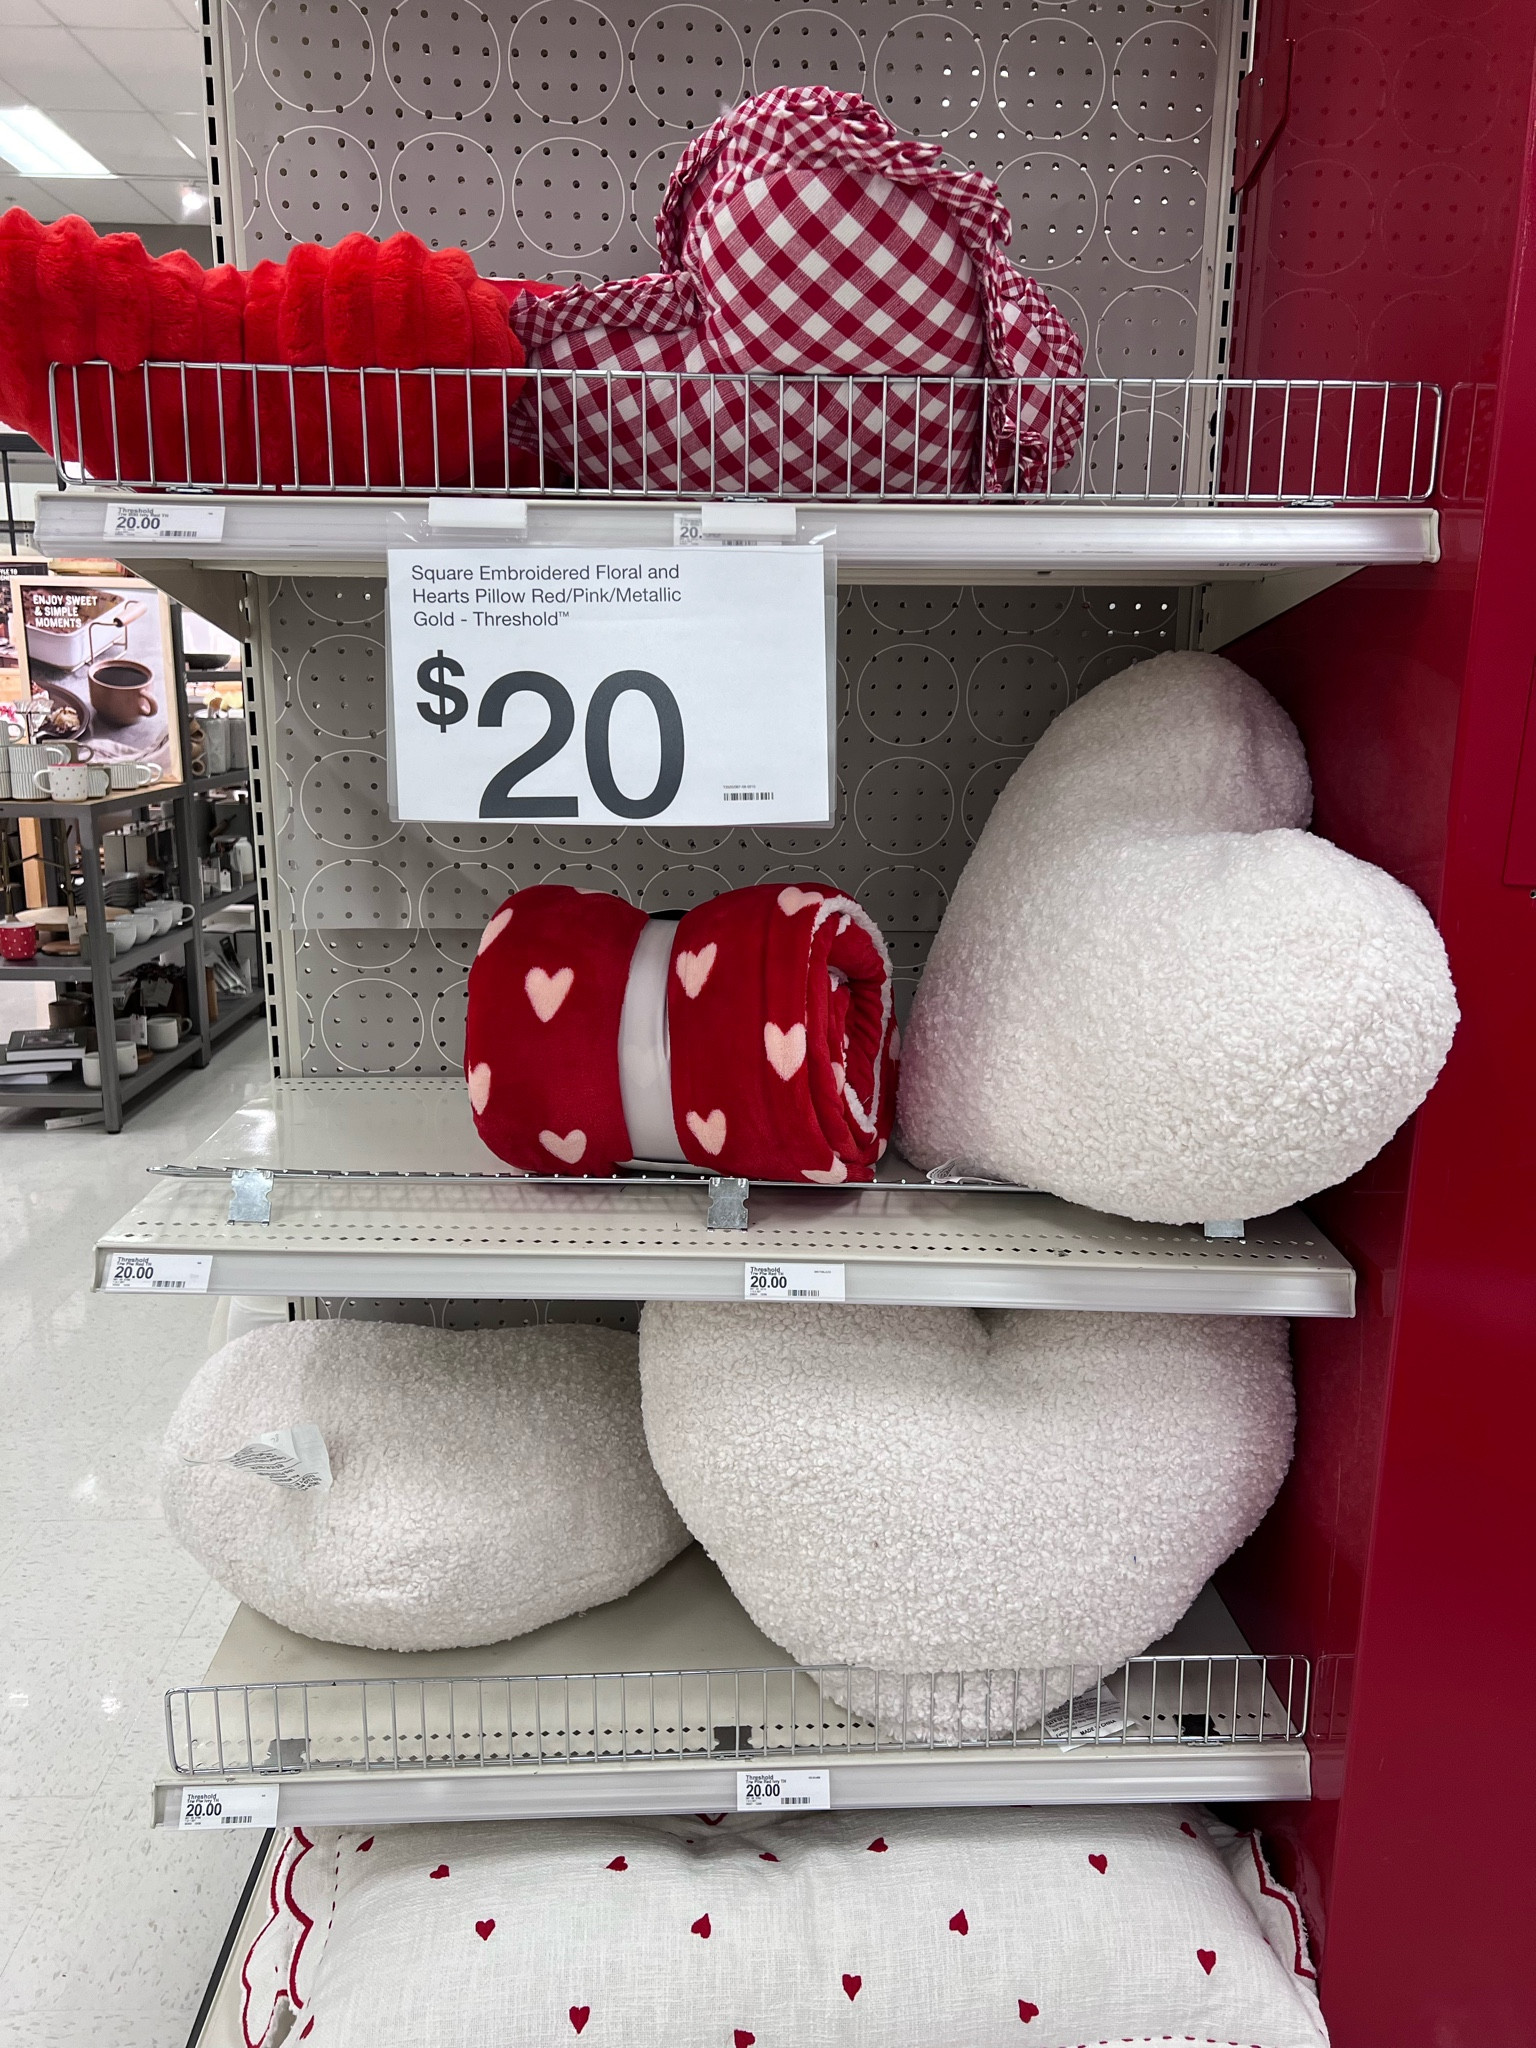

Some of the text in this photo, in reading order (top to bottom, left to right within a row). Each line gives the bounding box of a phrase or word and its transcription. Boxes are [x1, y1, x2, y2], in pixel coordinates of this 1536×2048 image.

[116, 517, 160, 529] 20.00
[412, 564, 680, 583] Square Embroidered Floral and
[33, 595, 98, 606] ENJOY SWEET
[413, 587, 682, 604] Hearts Pillow Red/Pink/Metallic
[35, 607, 79, 617] & SIMPLE
[413, 611, 455, 626] Gold
[36, 618, 82, 628] MOMENTS
[416, 649, 686, 820] $20
[115, 1266, 154, 1279] 20.00
[750, 1276, 787, 1288] 20.00
[746, 1784, 780, 1797] 20.00
[186, 1803, 222, 1816] 20.00
